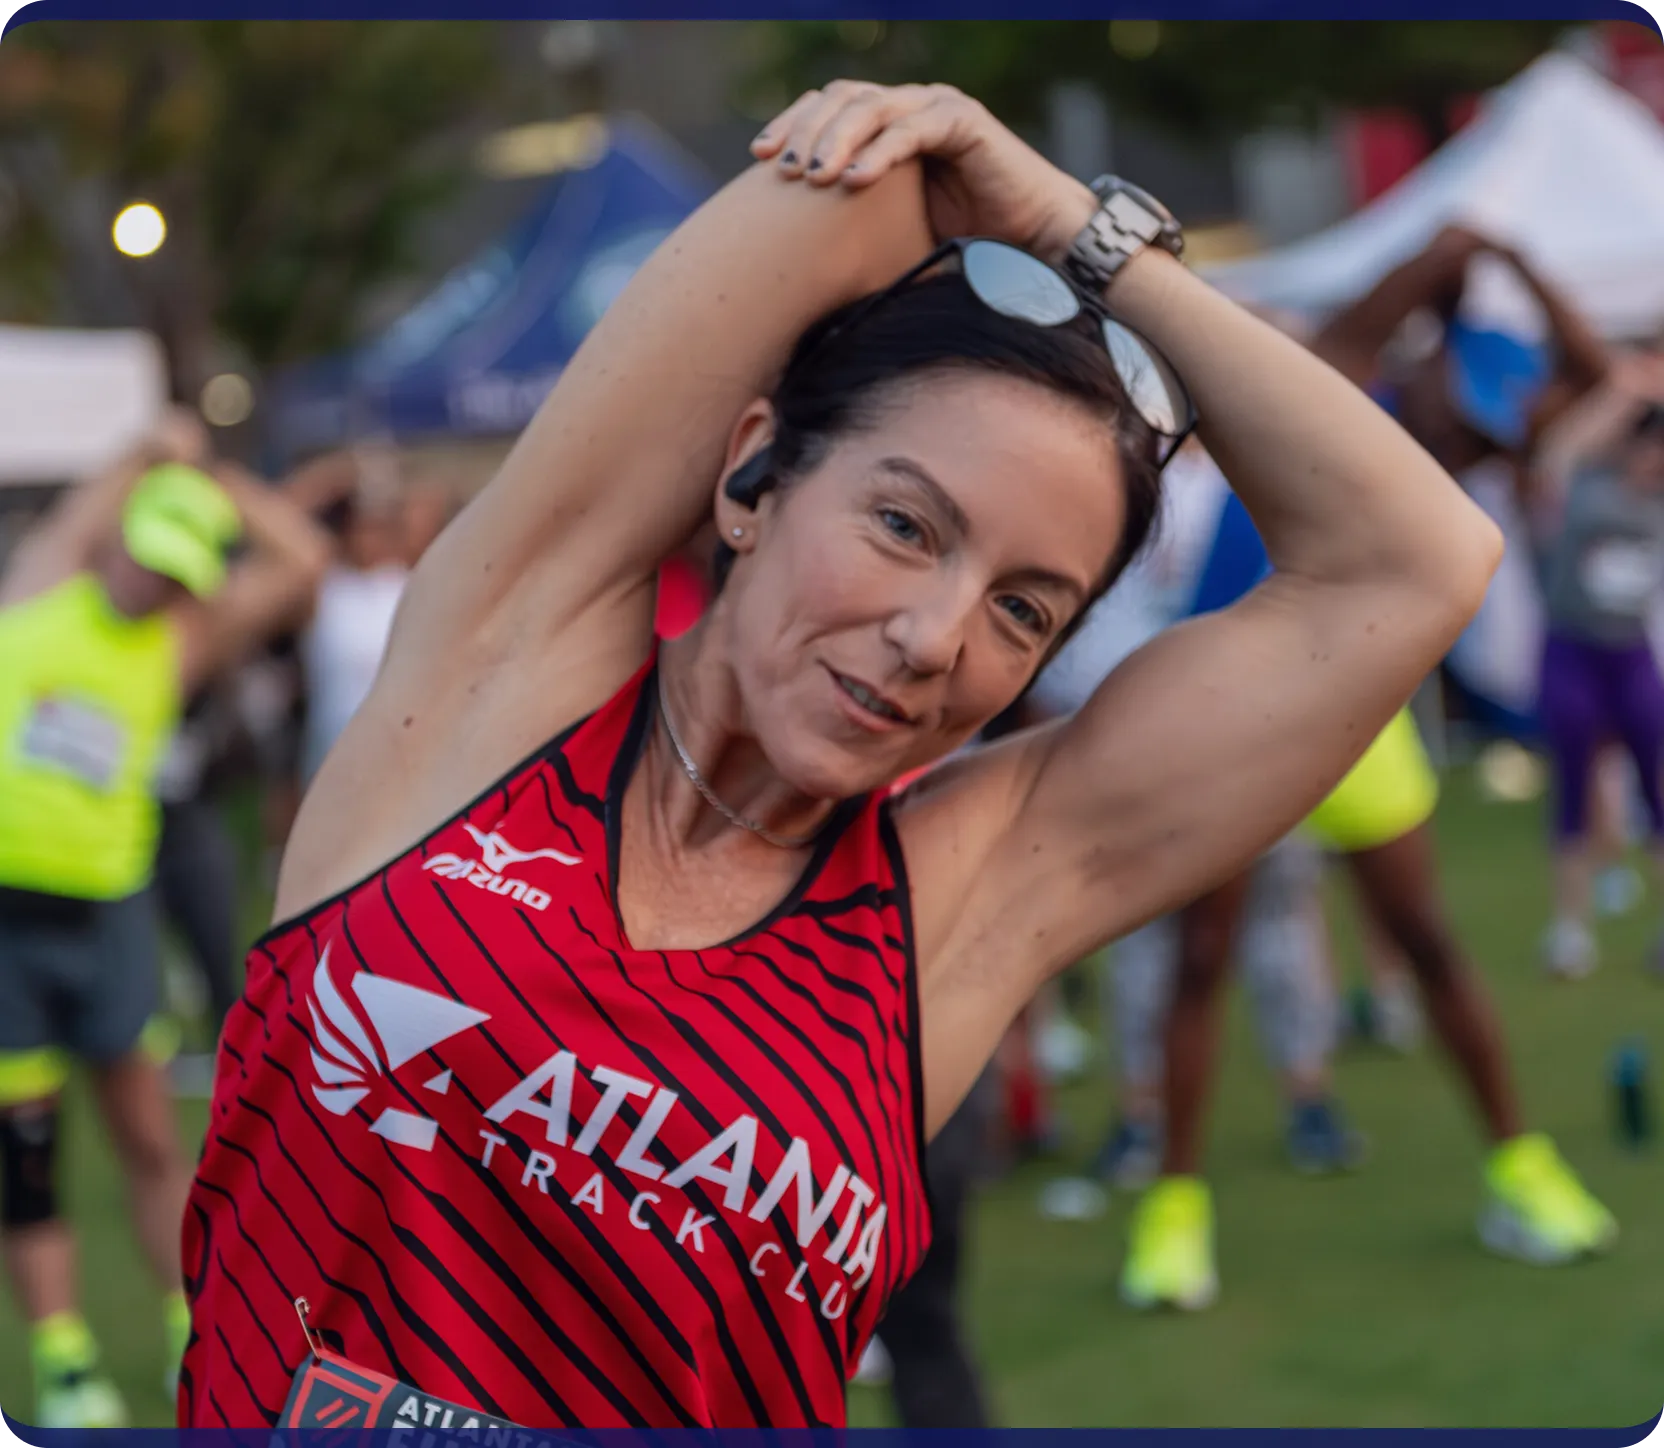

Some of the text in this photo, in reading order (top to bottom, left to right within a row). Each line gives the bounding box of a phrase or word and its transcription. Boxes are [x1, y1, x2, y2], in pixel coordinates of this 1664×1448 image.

[479, 1129, 848, 1320] TRACK CLU
[483, 1049, 888, 1291] ATLANTA
